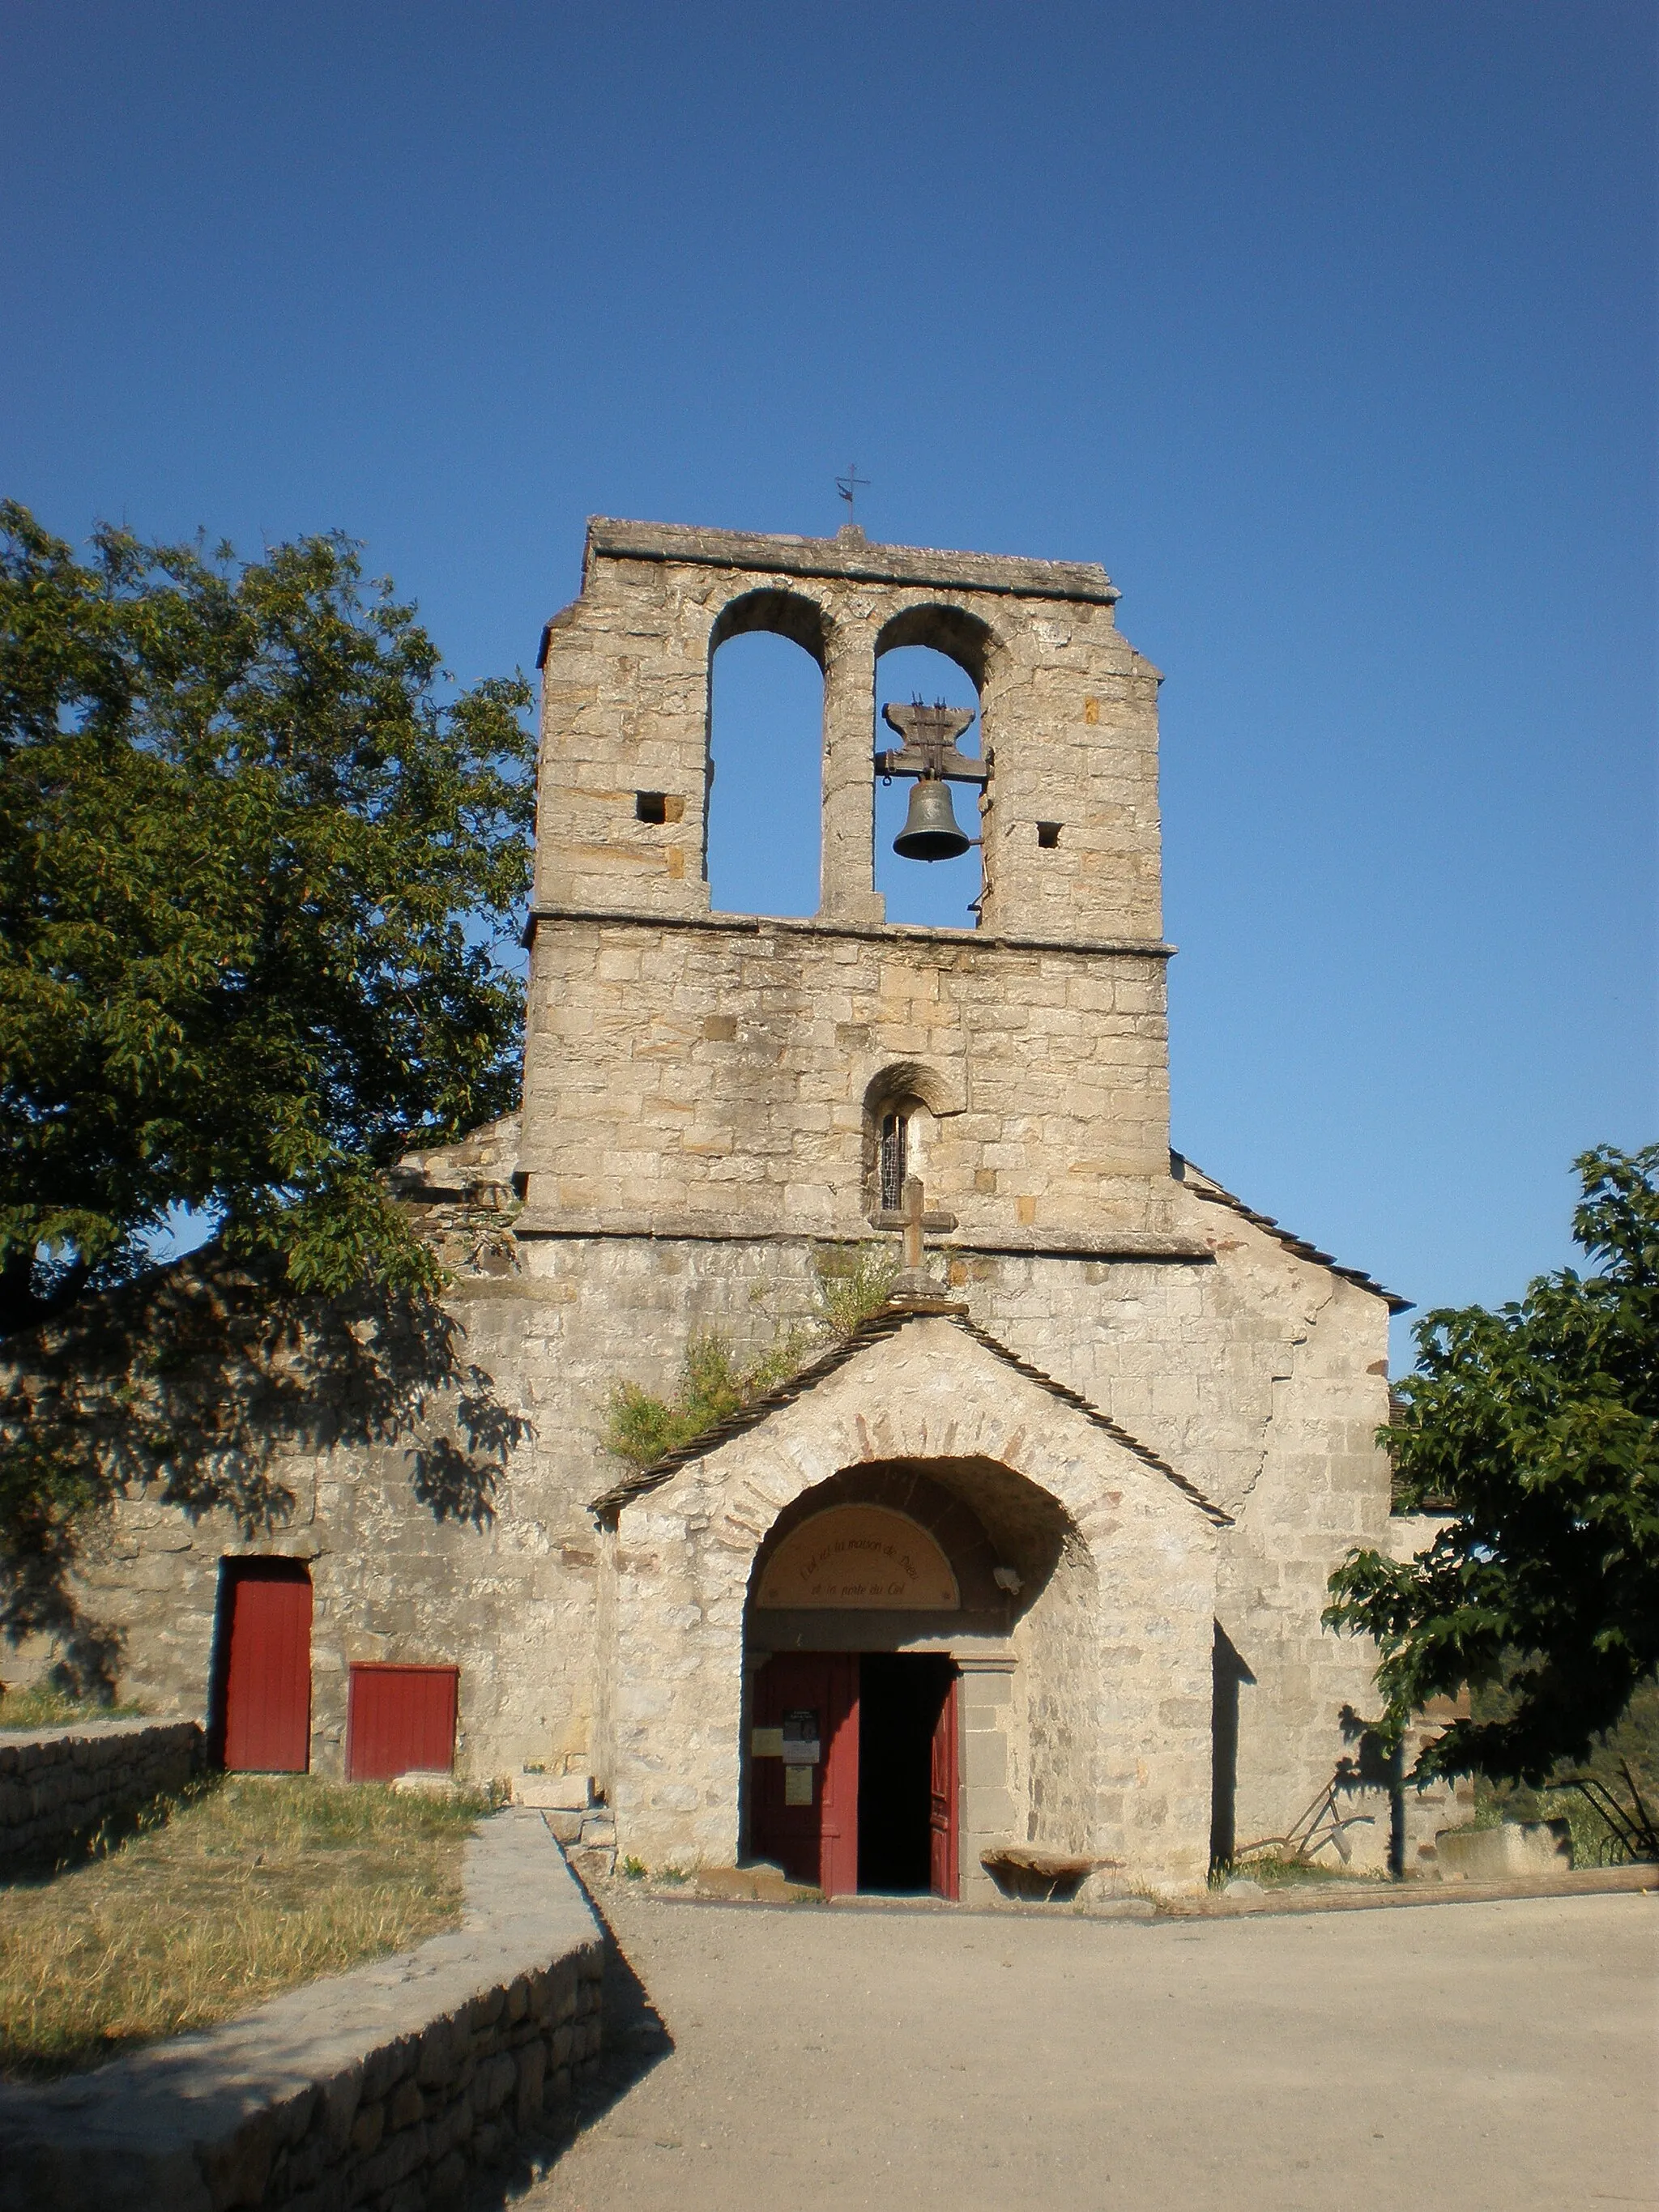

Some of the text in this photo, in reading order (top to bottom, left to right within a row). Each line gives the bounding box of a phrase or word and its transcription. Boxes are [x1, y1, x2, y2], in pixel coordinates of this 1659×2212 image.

[848, 1540, 882, 1551] maison
[884, 1544, 897, 1557] de
[900, 1555, 919, 1580] Dieu
[841, 1583, 866, 1598] porte
[870, 1583, 883, 1595] du
[887, 1581, 906, 1595] Ciel
